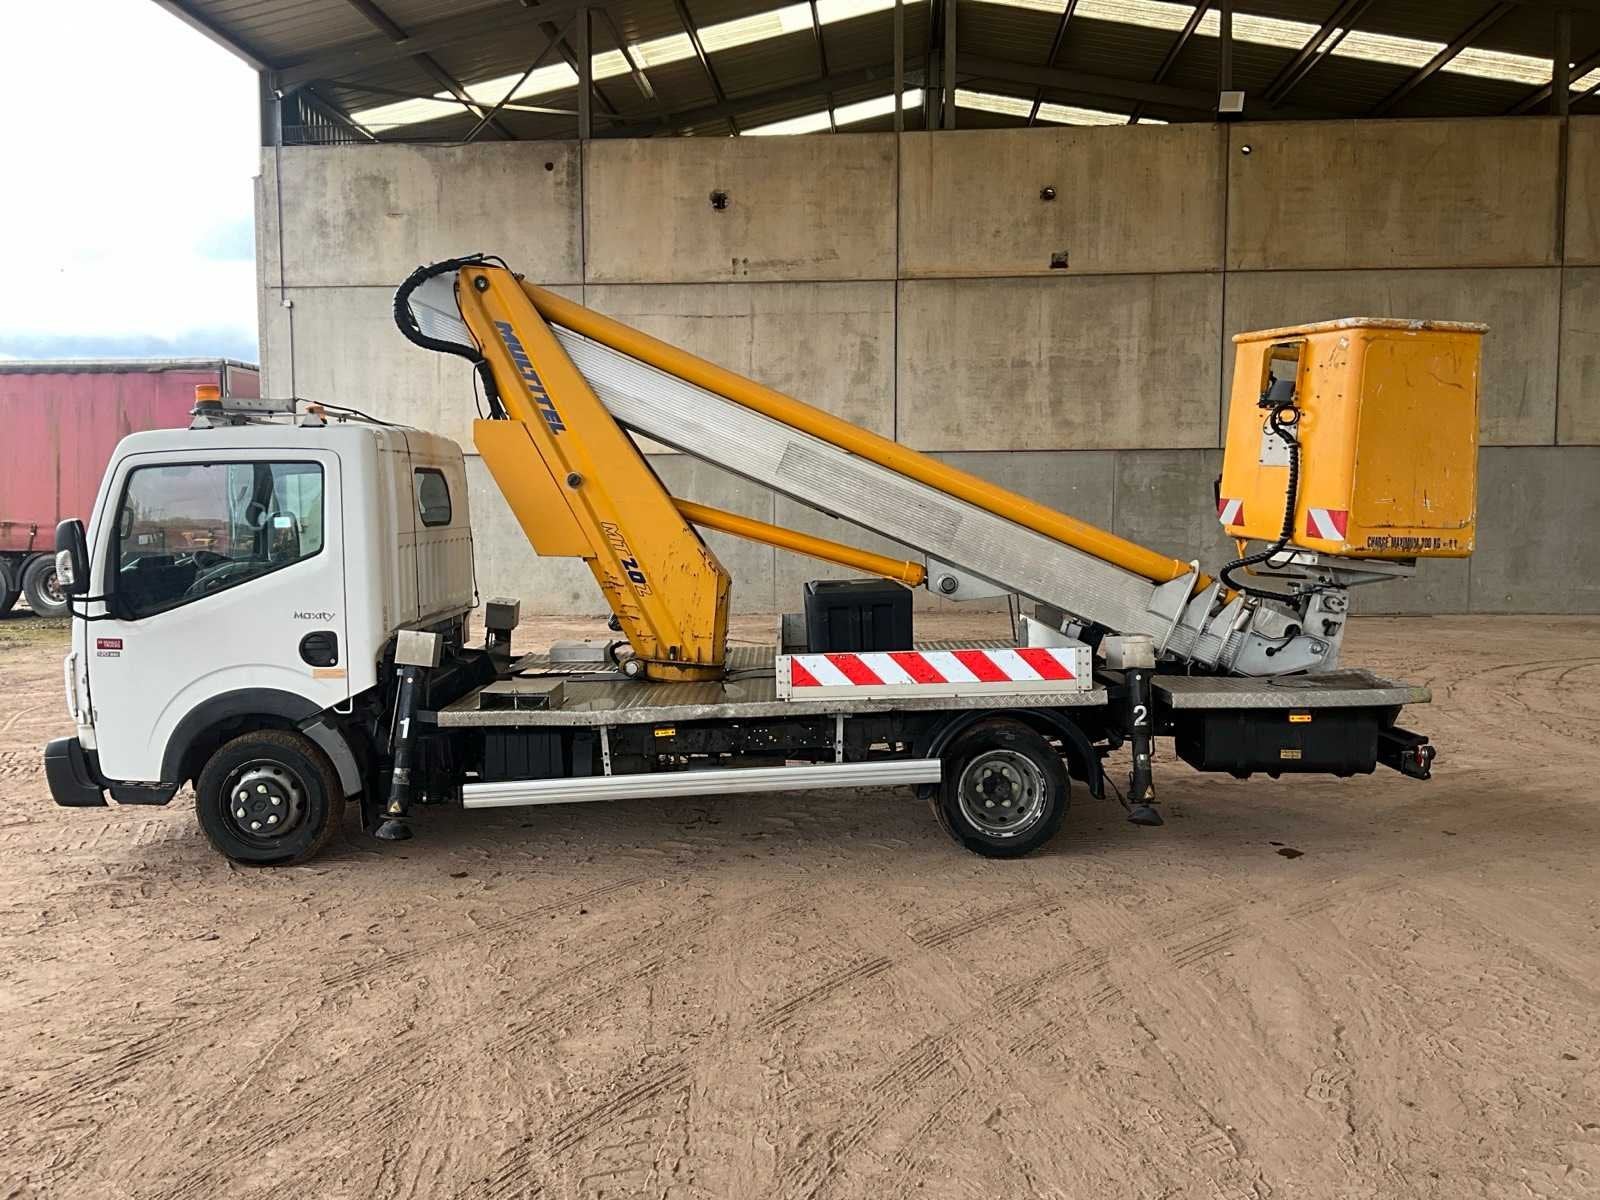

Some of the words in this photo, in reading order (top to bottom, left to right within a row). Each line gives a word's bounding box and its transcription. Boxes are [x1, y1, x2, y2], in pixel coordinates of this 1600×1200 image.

[494, 320, 566, 435] MULTITEL
[293, 611, 336, 623] Maxity
[1133, 704, 1147, 726] 2
[400, 717, 410, 739] 1
